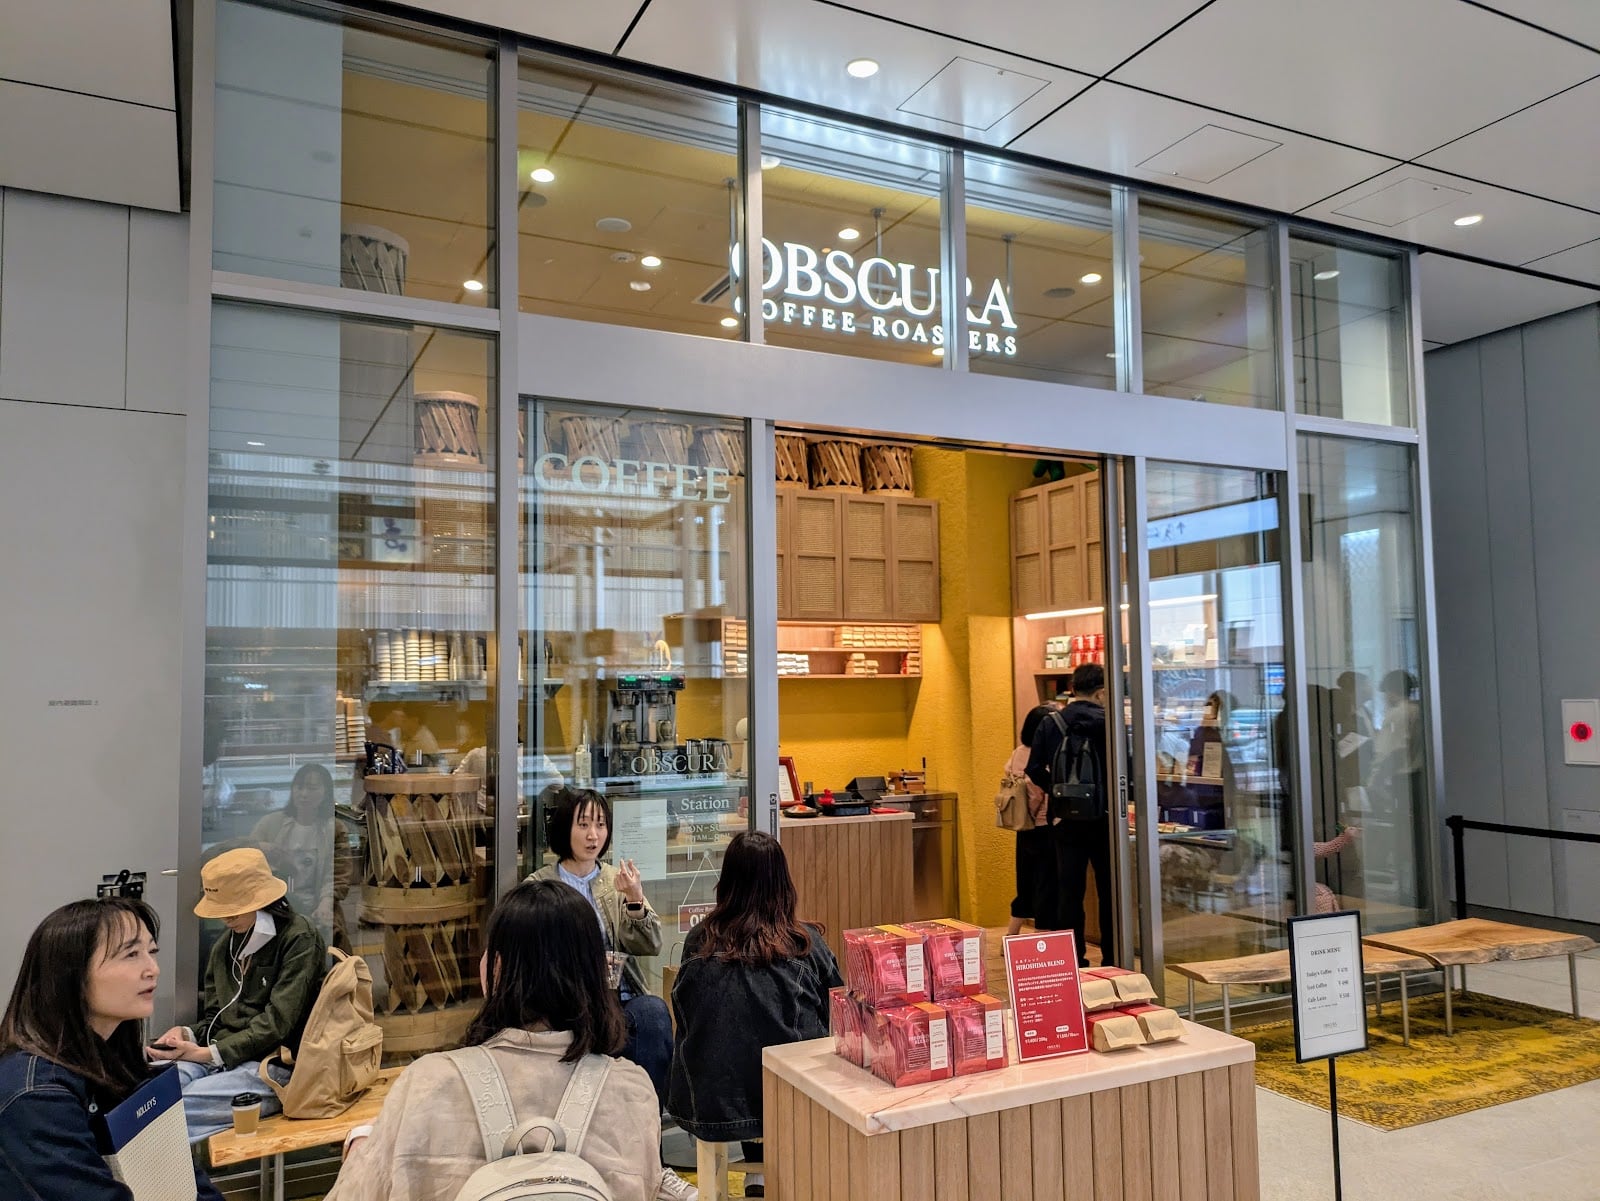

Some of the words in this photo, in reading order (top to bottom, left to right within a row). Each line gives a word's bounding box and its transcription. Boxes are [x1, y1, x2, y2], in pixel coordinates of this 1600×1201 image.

[872, 315, 1017, 356] ROASERS
[534, 453, 732, 503] COFFEE
[631, 753, 729, 774] OBSCURA
[681, 796, 730, 811] Station
[1016, 961, 1047, 971] HIROSHIMA
